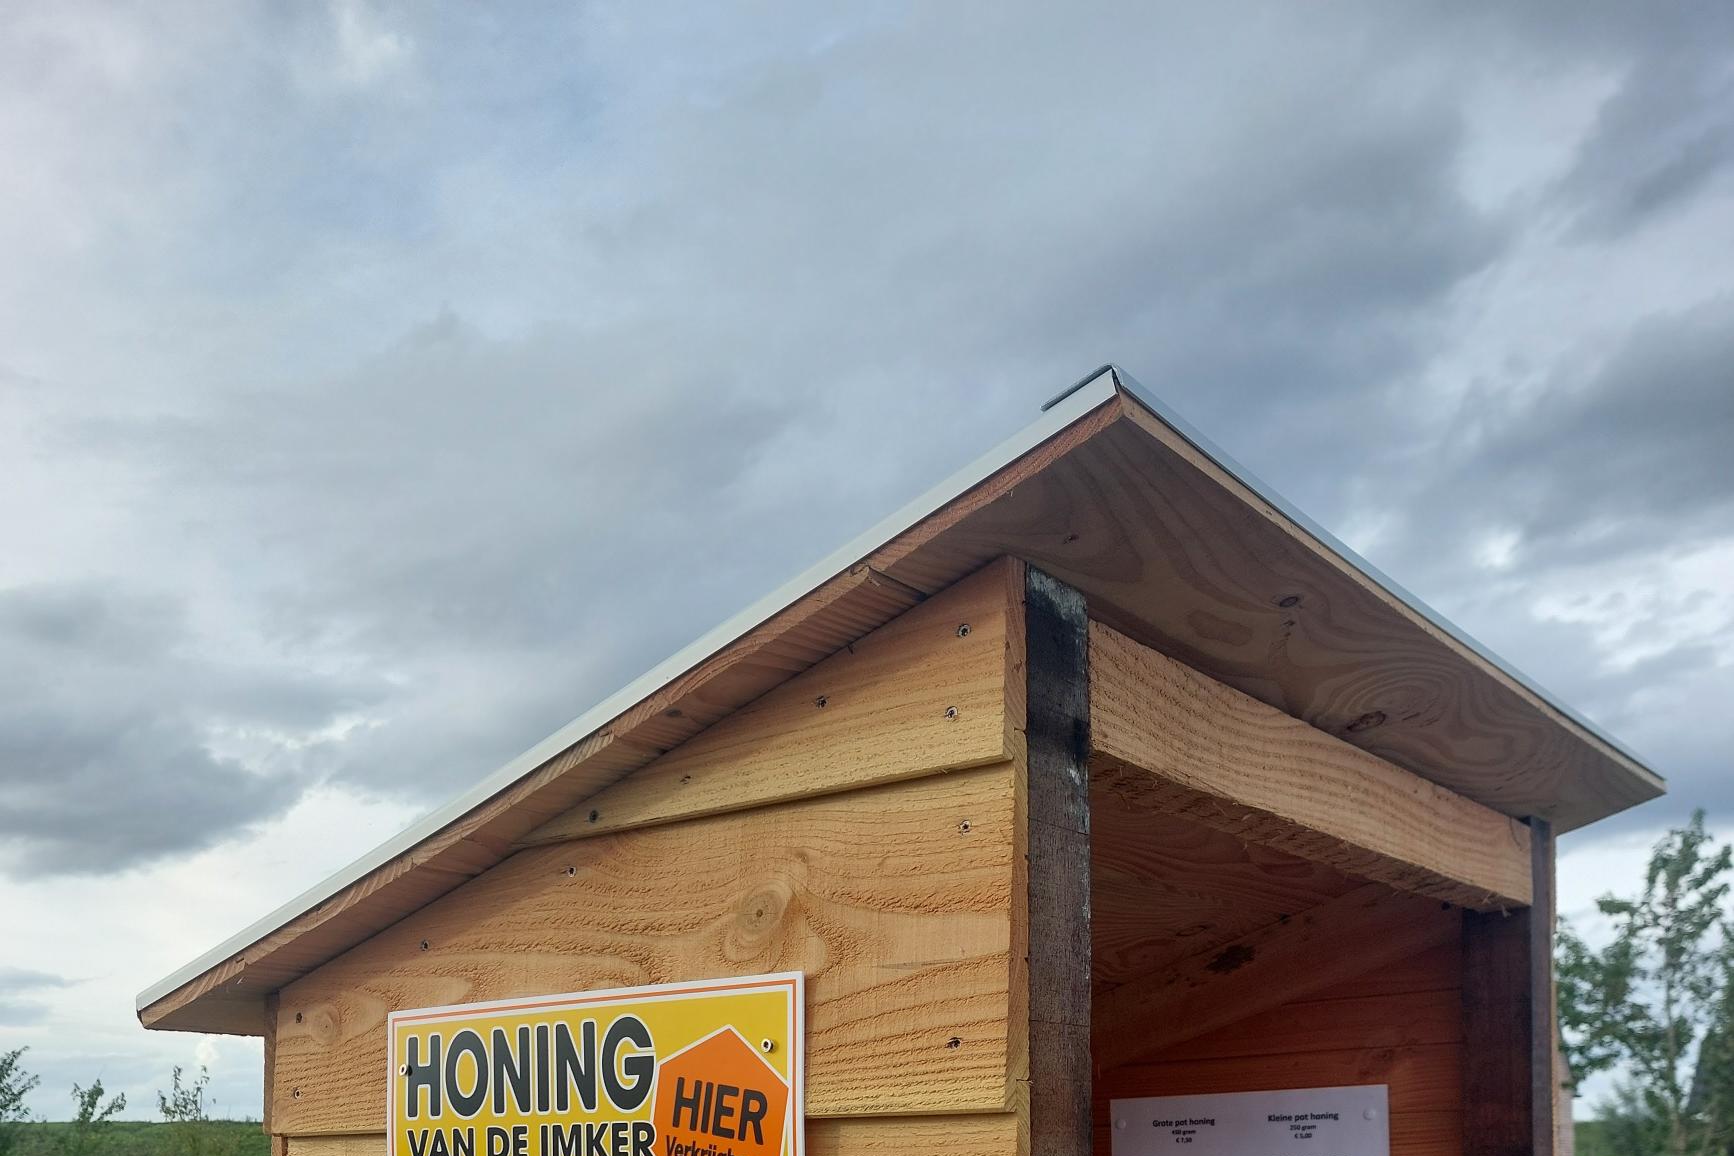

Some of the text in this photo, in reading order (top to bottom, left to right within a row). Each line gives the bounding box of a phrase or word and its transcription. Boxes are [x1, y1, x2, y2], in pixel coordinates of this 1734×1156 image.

[407, 1016, 655, 1118] HONING
[671, 1077, 768, 1145] HIER
[1152, 1117, 1215, 1127] Grote pot honing
[1268, 1112, 1339, 1122] Kleine pot honing
